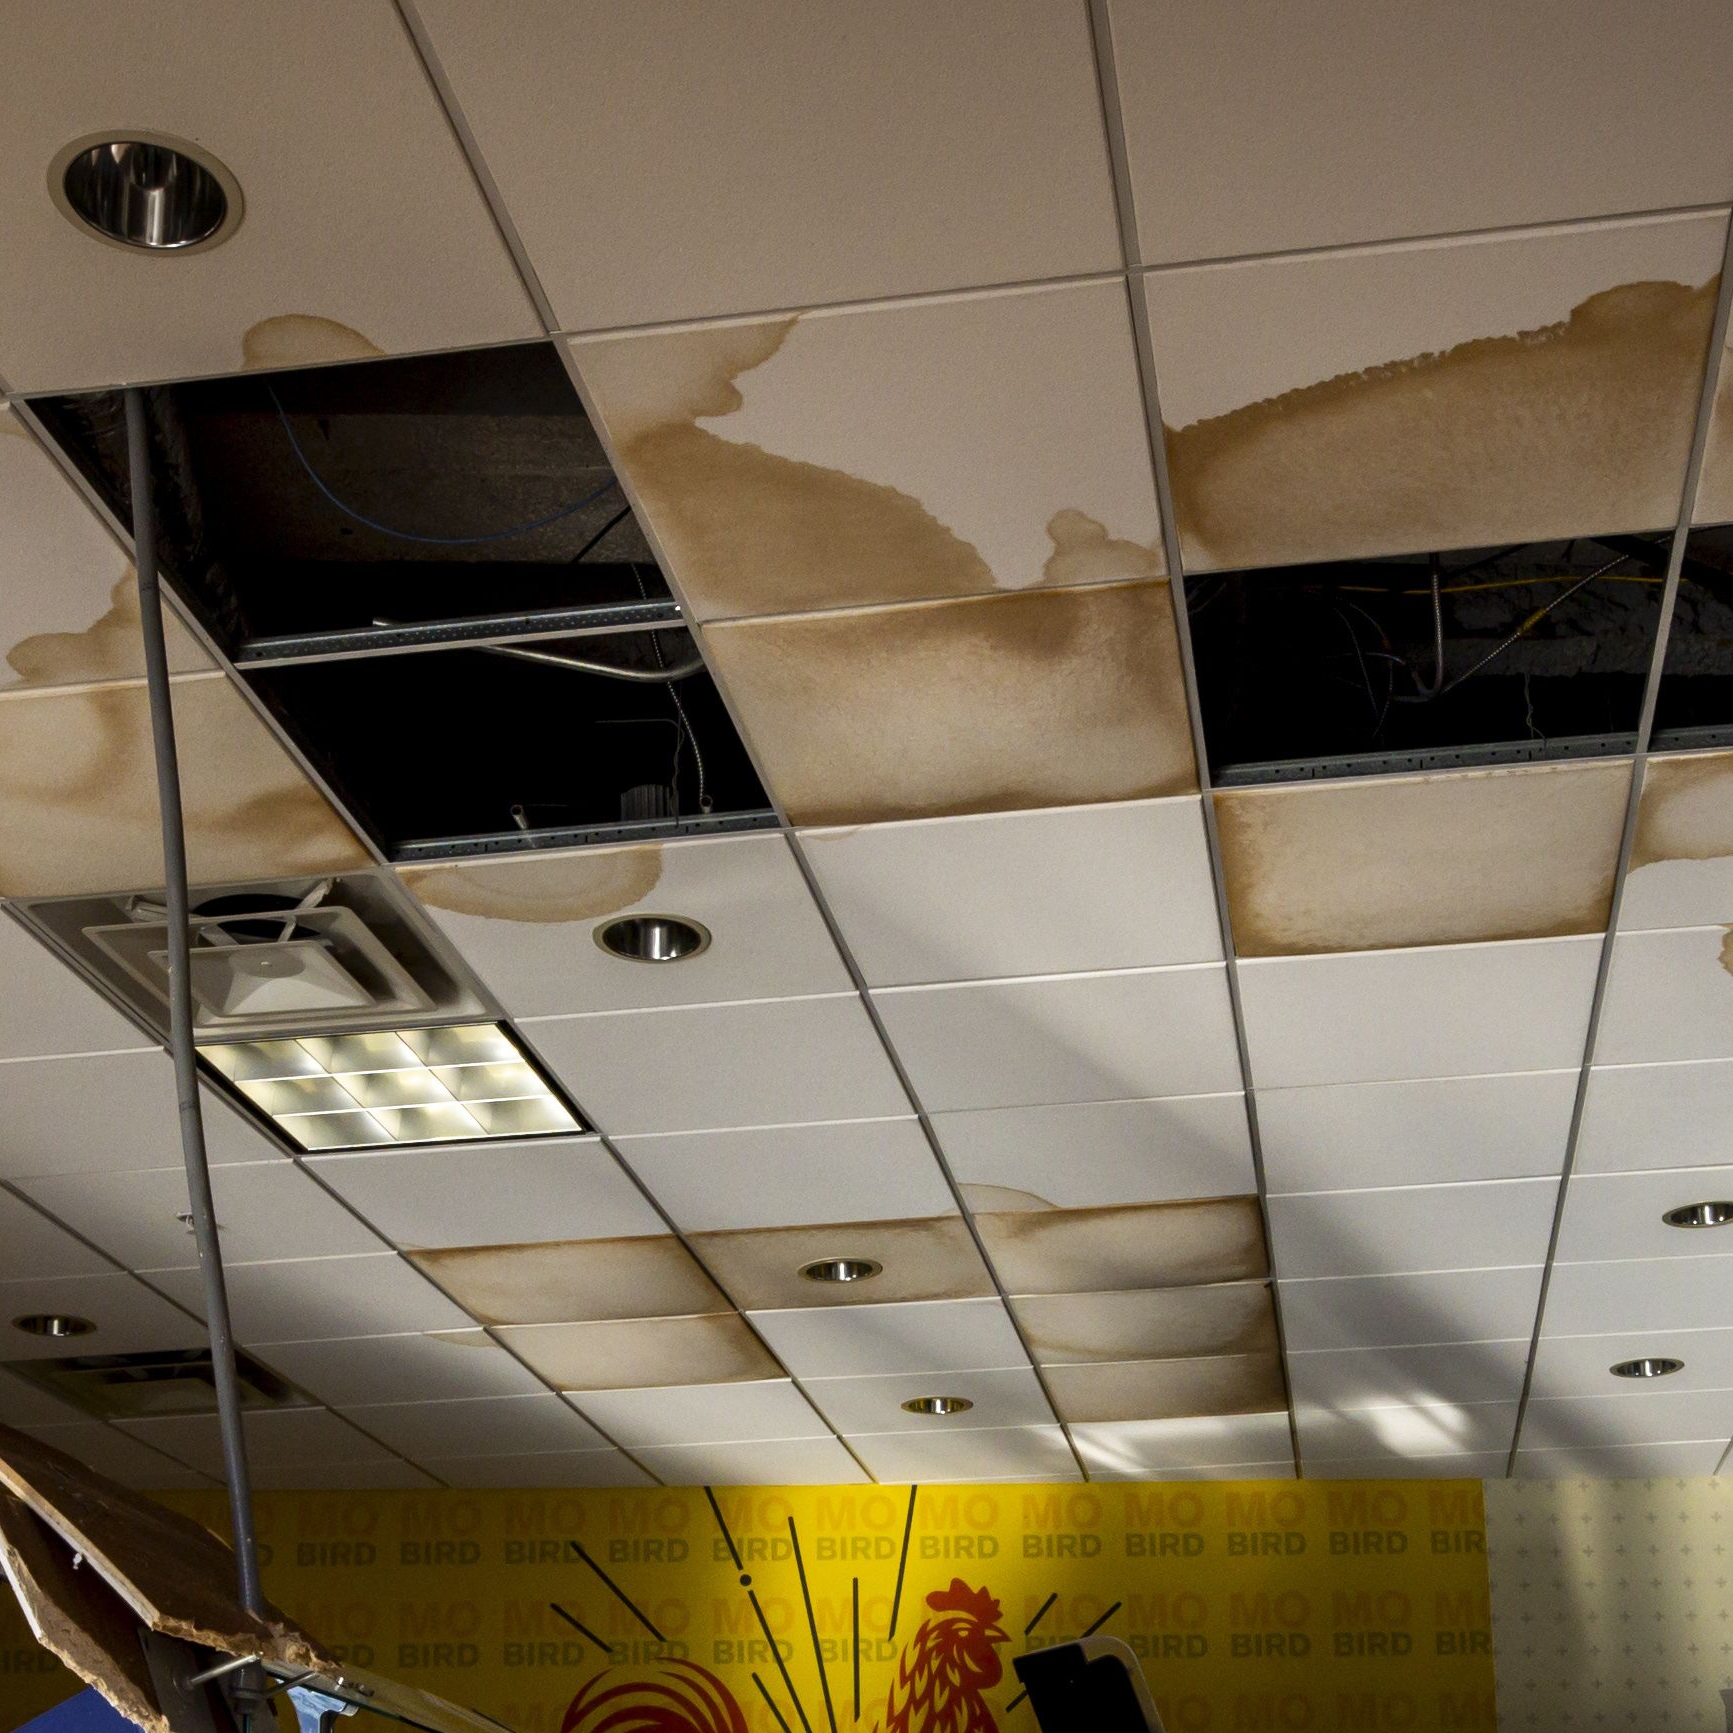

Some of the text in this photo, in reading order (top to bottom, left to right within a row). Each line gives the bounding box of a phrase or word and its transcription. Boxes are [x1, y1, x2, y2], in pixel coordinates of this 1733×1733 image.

[1125, 1492, 1204, 1528] MO
[1226, 1491, 1305, 1527] MO
[1328, 1490, 1406, 1526] MO
[297, 1541, 376, 1567] BIRD
[400, 1540, 480, 1565] BIRD
[505, 1539, 583, 1565] BIRD
[608, 1539, 689, 1563] BIRD
[713, 1538, 793, 1562] BIRD
[816, 1537, 896, 1560] BIRD
[920, 1536, 999, 1559] BIRD
[1022, 1534, 1101, 1558] BIRD
[1125, 1533, 1204, 1557] BIRD
[1227, 1532, 1306, 1556] BIRD
[1329, 1530, 1407, 1555] BIRD
[398, 1643, 478, 1667] BIRD
[504, 1642, 584, 1666] BIRD
[608, 1642, 689, 1665] BIRD
[713, 1641, 794, 1664] BIRD
[817, 1639, 898, 1663] BIRD
[1231, 1633, 1310, 1657] BIRD
[1333, 1631, 1412, 1656] BIRD
